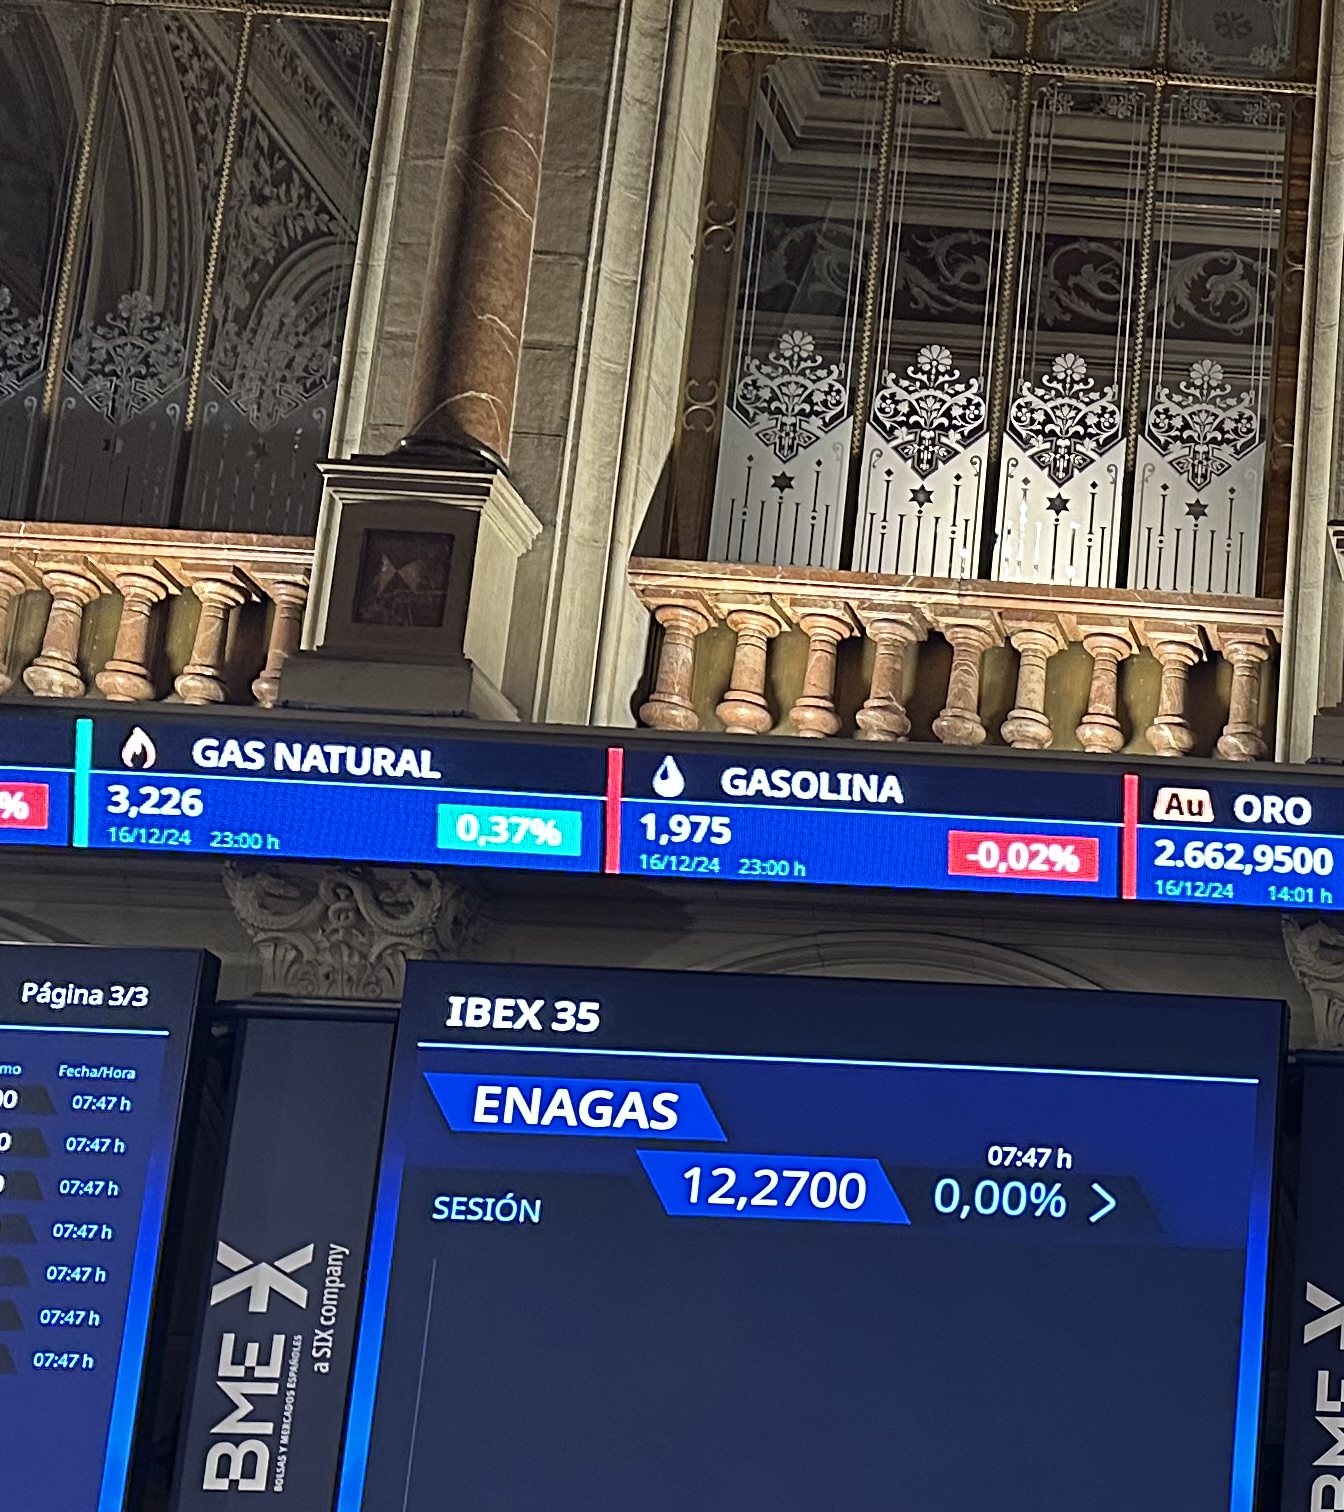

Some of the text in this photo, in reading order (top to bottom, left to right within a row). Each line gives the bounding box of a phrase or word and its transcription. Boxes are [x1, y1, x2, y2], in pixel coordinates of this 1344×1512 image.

[192, 738, 441, 779] GAS NATURAL
[107, 785, 203, 818] 3,226
[721, 768, 904, 804] GASOLINA
[1165, 793, 1311, 825] Au ORO
[108, 827, 280, 849] 16/12/24 23:00 h
[457, 814, 562, 846] 0,37%
[639, 813, 731, 845] 1,975
[966, 841, 1080, 876] -0,02%
[1154, 839, 1334, 875] 2.662,9500
[22, 982, 149, 1009] Página 3/3
[446, 996, 599, 1032] IBEX 35
[59, 1065, 135, 1079] Fecha/Hora
[73, 1095, 131, 1111] 07:47 h
[474, 1086, 679, 1130] ENAGAS
[988, 1146, 1072, 1169] 07:47 h
[684, 1167, 866, 1210] 12,2700
[935, 1179, 1066, 1219] 0,00%
[432, 1193, 541, 1223] SESIÓN
[311, 1243, 350, 1374] a SIX company
[202, 1332, 286, 1492] BME
